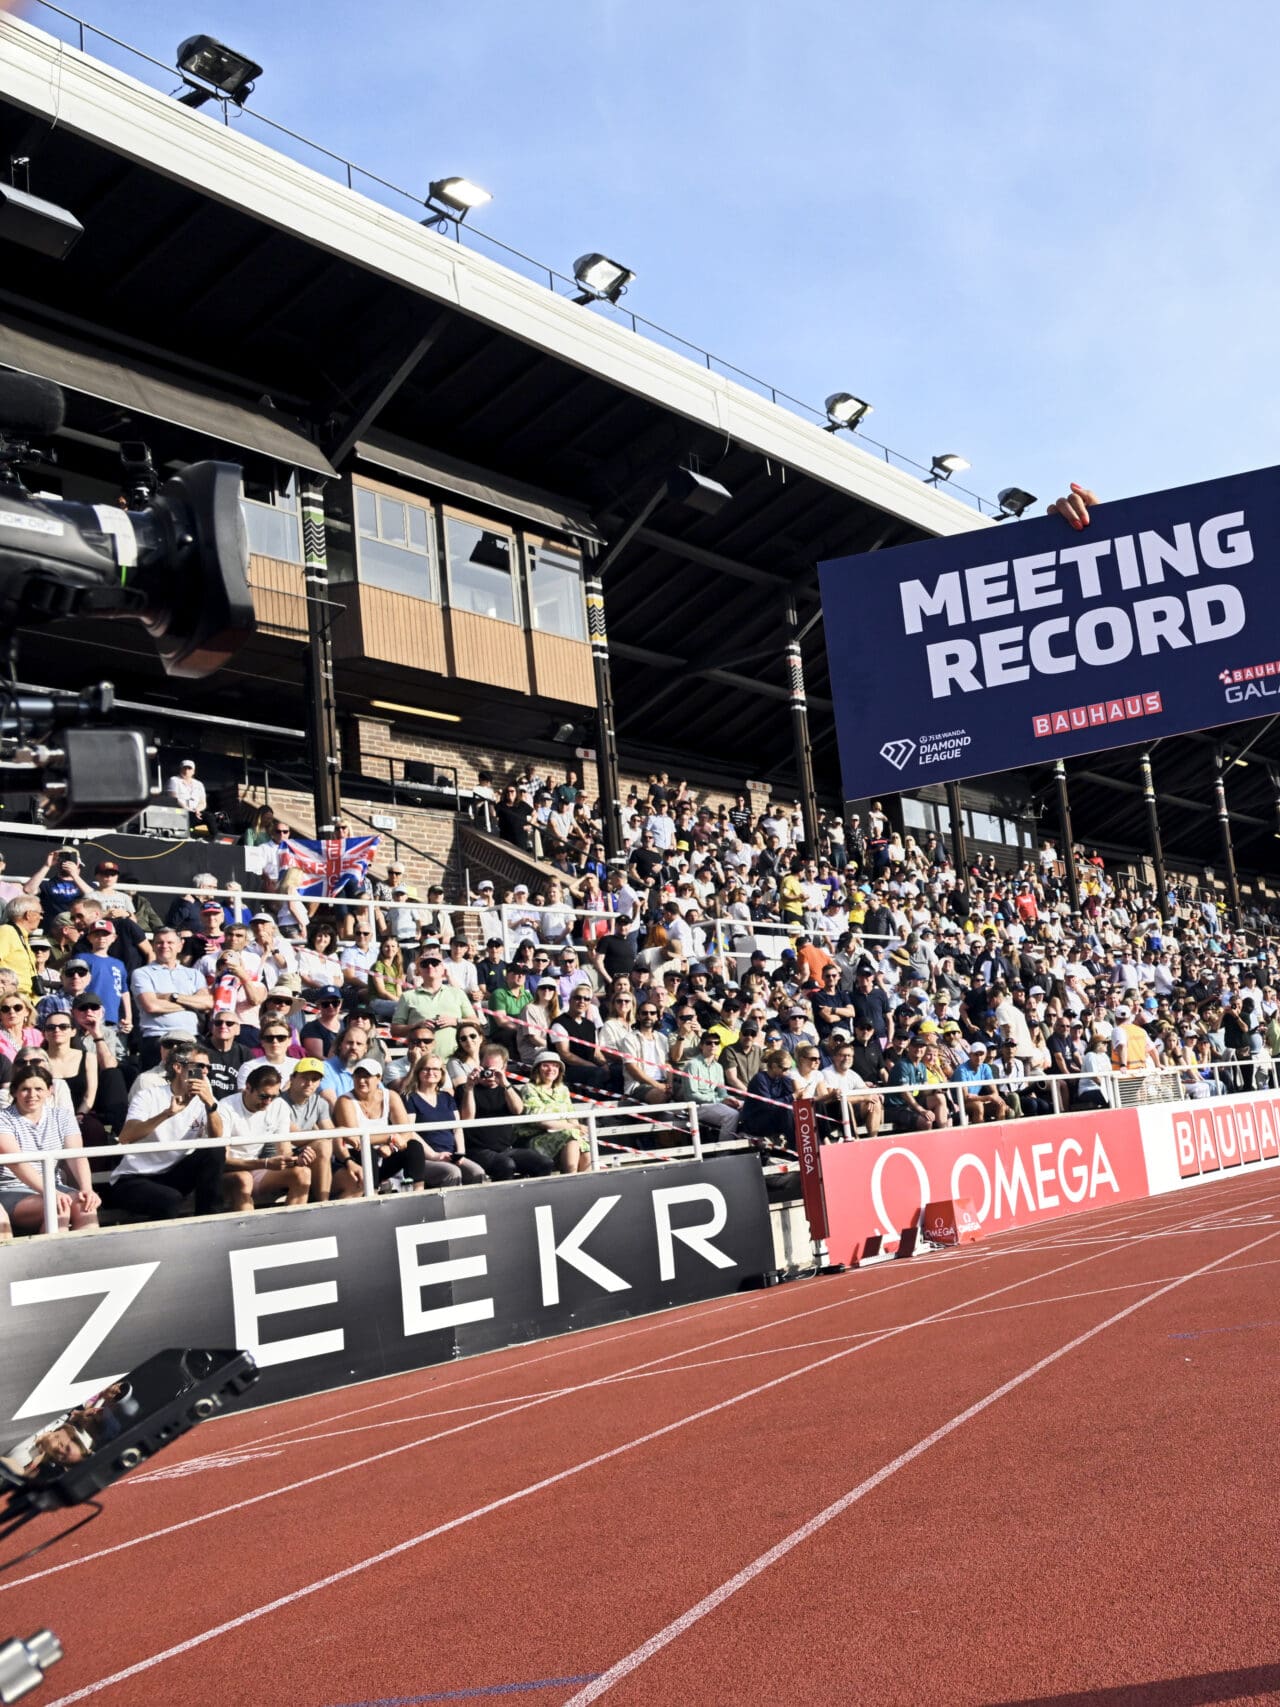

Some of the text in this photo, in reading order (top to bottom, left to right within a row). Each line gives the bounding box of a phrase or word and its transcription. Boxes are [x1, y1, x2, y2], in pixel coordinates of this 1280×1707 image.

[899, 510, 1254, 635] MEETING
[926, 584, 1246, 699] RECORD
[942, 729, 966, 738] WANDA
[1035, 693, 1160, 735] BAUHAUS
[919, 748, 961, 765] LEAGUE
[920, 736, 971, 754] DIAMOND
[801, 1123, 814, 1174] OMEGA
[950, 1132, 1120, 1222] OMEGA
[925, 1226, 955, 1238] OMEGA
[10, 1182, 738, 1421] ZEEKR
